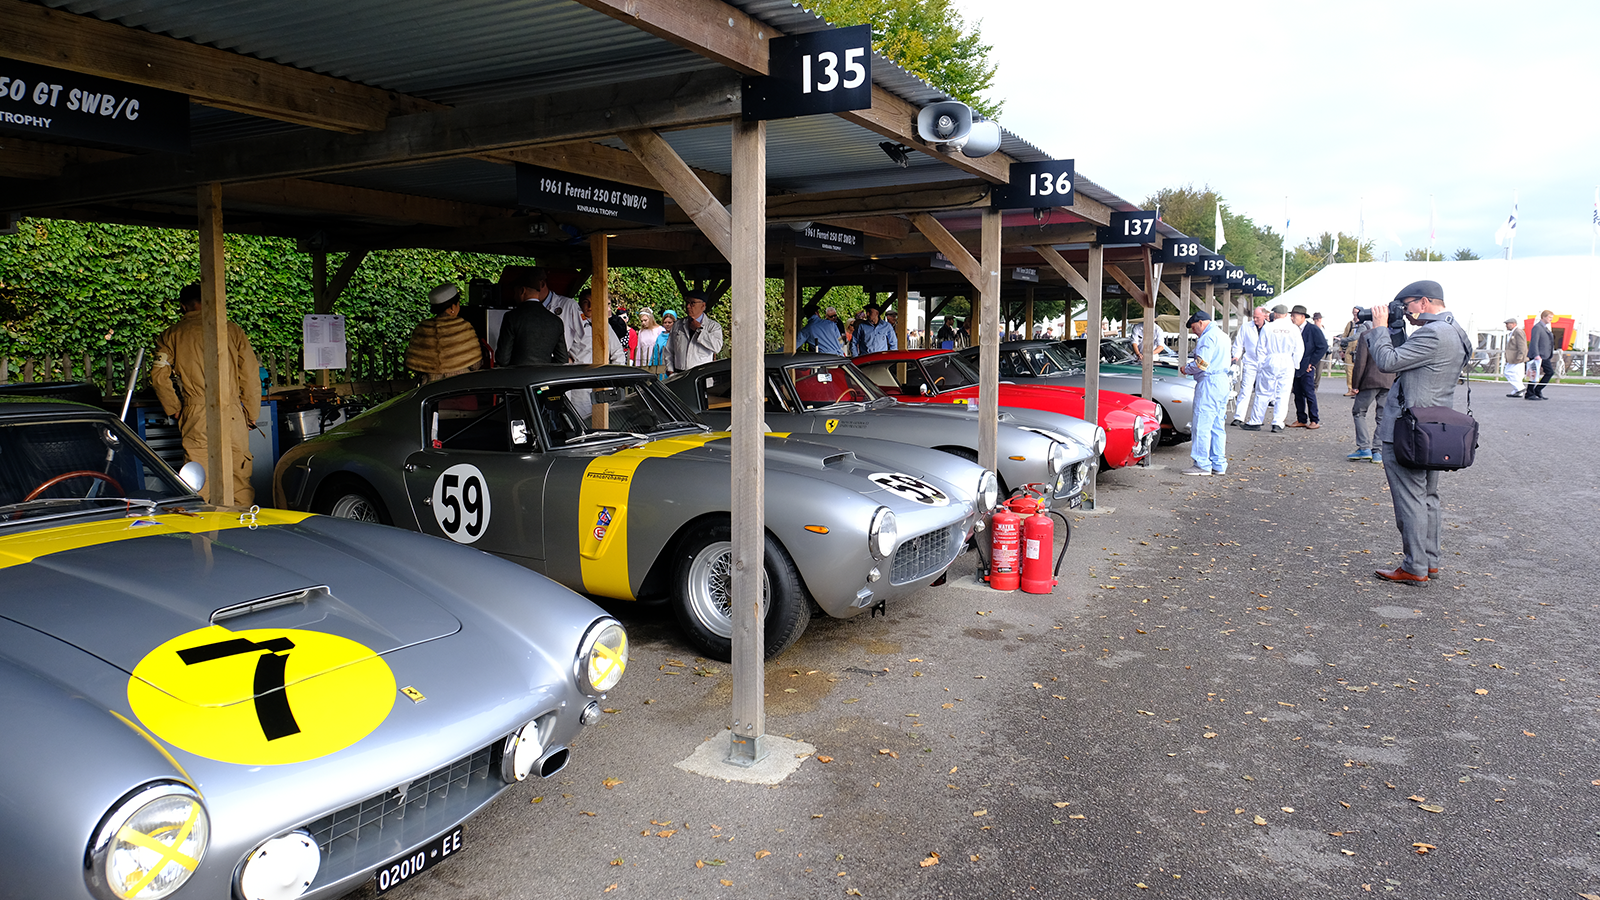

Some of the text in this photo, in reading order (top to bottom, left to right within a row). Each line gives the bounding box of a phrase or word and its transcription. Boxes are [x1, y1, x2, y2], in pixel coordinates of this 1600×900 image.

[802, 47, 865, 93] 135
[33, 82, 63, 107] GT
[67, 88, 139, 121] SWB/C
[0, 111, 52, 128] TROPHY
[540, 178, 647, 210] 1961 Ferrari 250 GT SWB/C
[1029, 172, 1071, 196] 136
[577, 204, 618, 217] KINRARA TROPHY
[1124, 218, 1154, 236] 137
[1173, 243, 1198, 257] 138
[1204, 259, 1224, 271] 139
[1226, 269, 1244, 279] 140
[1242, 277, 1255, 286] 141
[1253, 283, 1267, 291] 42
[874, 475, 946, 504] 59
[442, 474, 484, 537] 59
[176, 637, 301, 741] 7
[379, 829, 461, 891] 02010 EE
